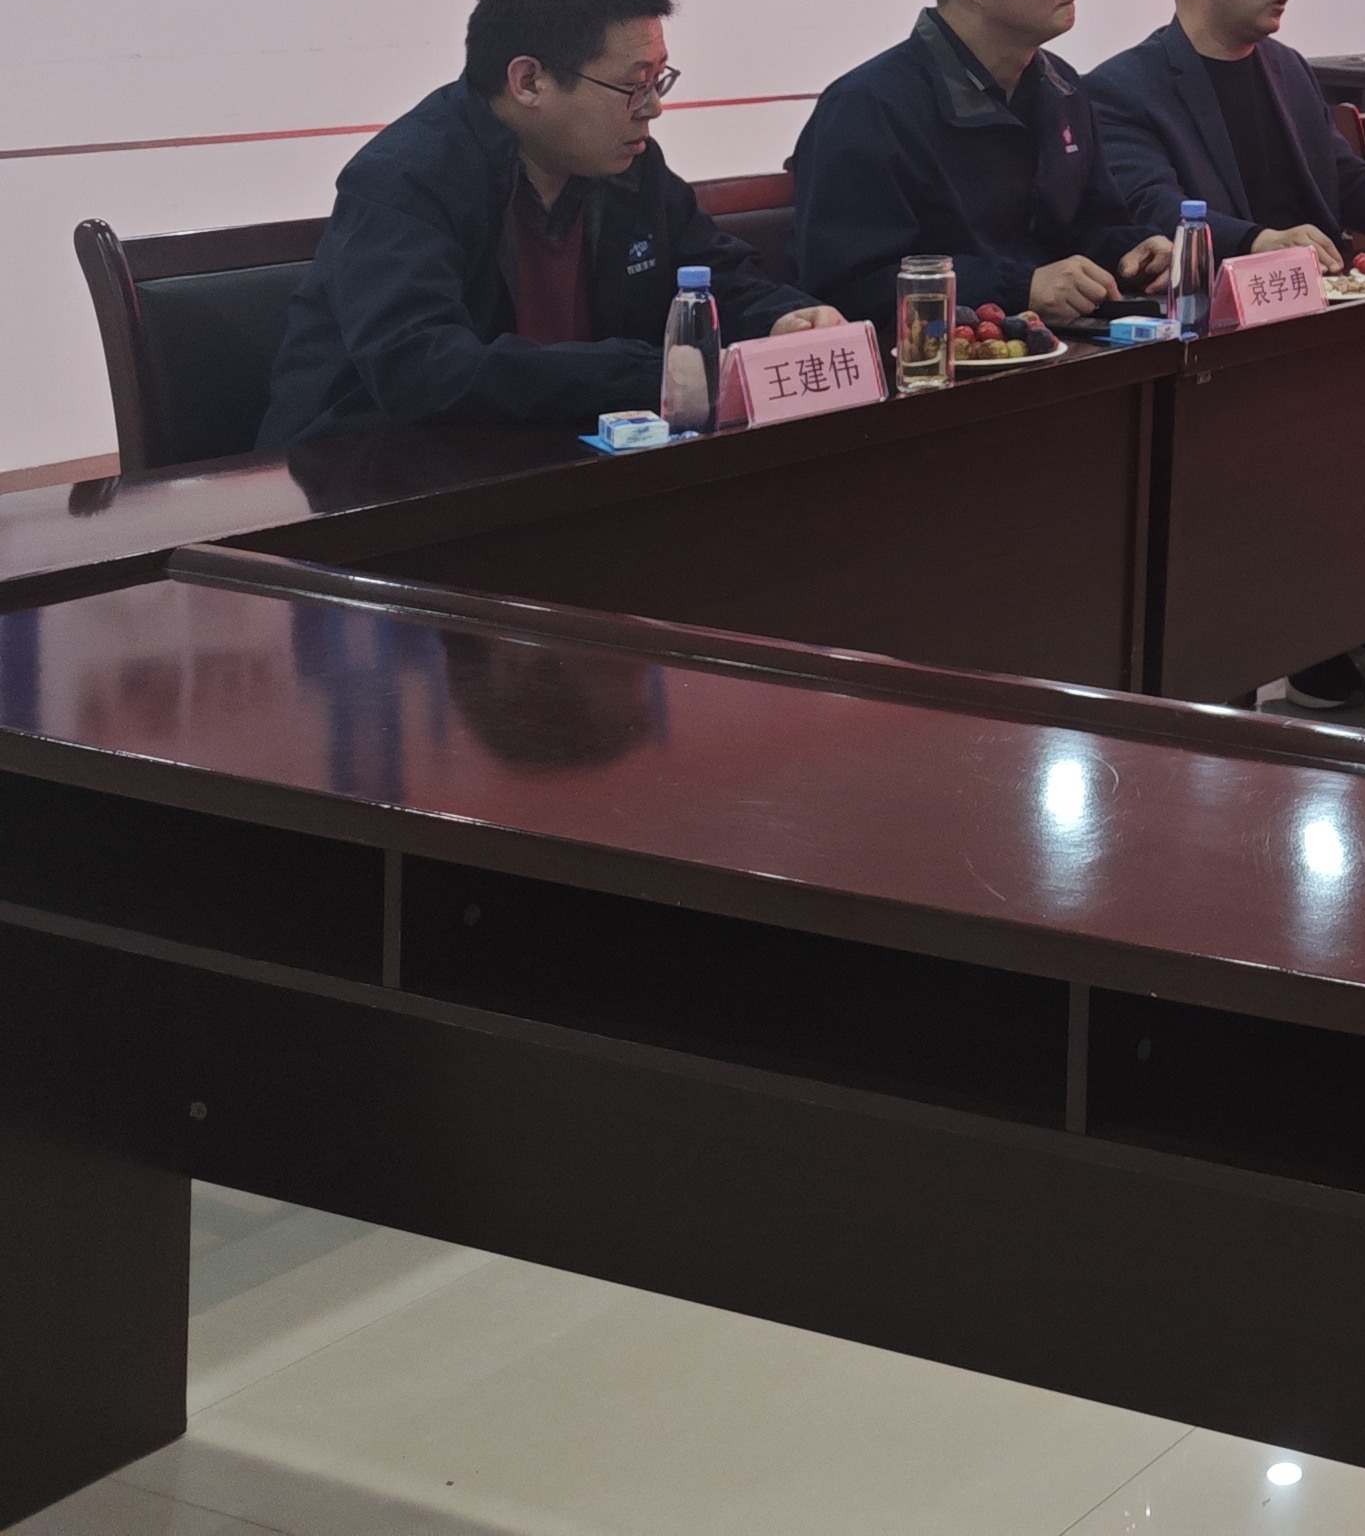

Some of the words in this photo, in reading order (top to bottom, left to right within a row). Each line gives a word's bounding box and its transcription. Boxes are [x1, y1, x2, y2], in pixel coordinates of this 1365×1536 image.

[1247, 266, 1309, 306] 袁学勇
[763, 347, 860, 401] 王建伟
